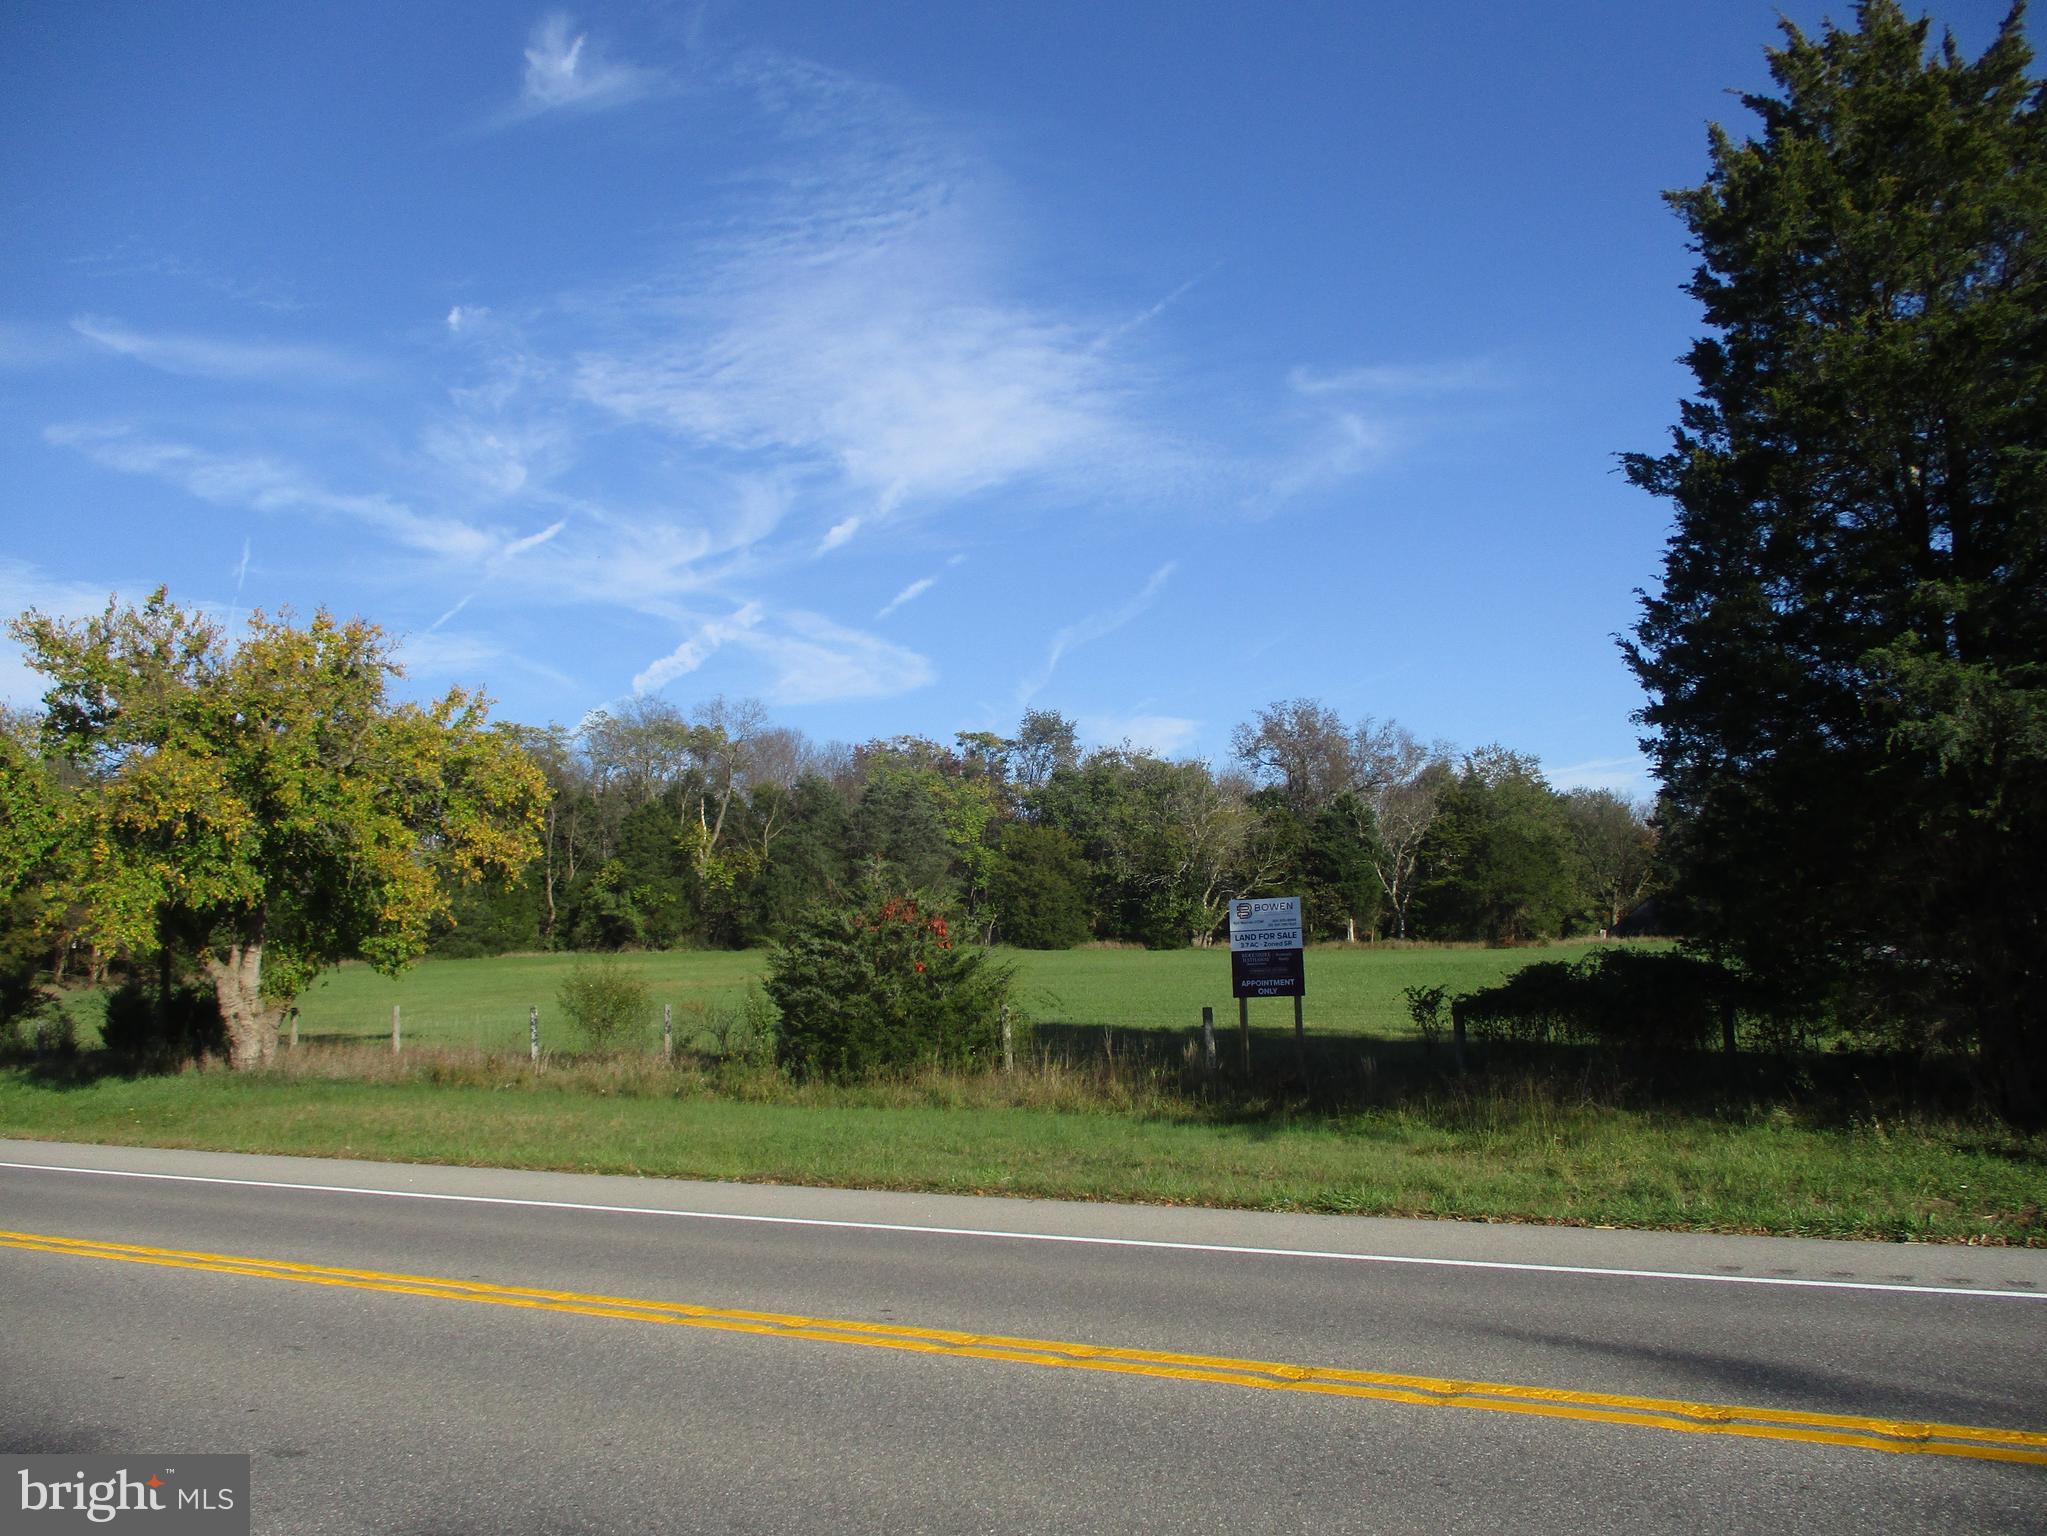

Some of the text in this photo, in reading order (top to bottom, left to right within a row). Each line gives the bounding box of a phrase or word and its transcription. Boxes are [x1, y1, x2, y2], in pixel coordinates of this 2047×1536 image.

[1254, 902, 1293, 911] BOWEN
[1235, 931, 1297, 941] LAND FOR SALE
[1241, 978, 1295, 987] APPOINTMENT
[1257, 987, 1278, 995] ONLY
